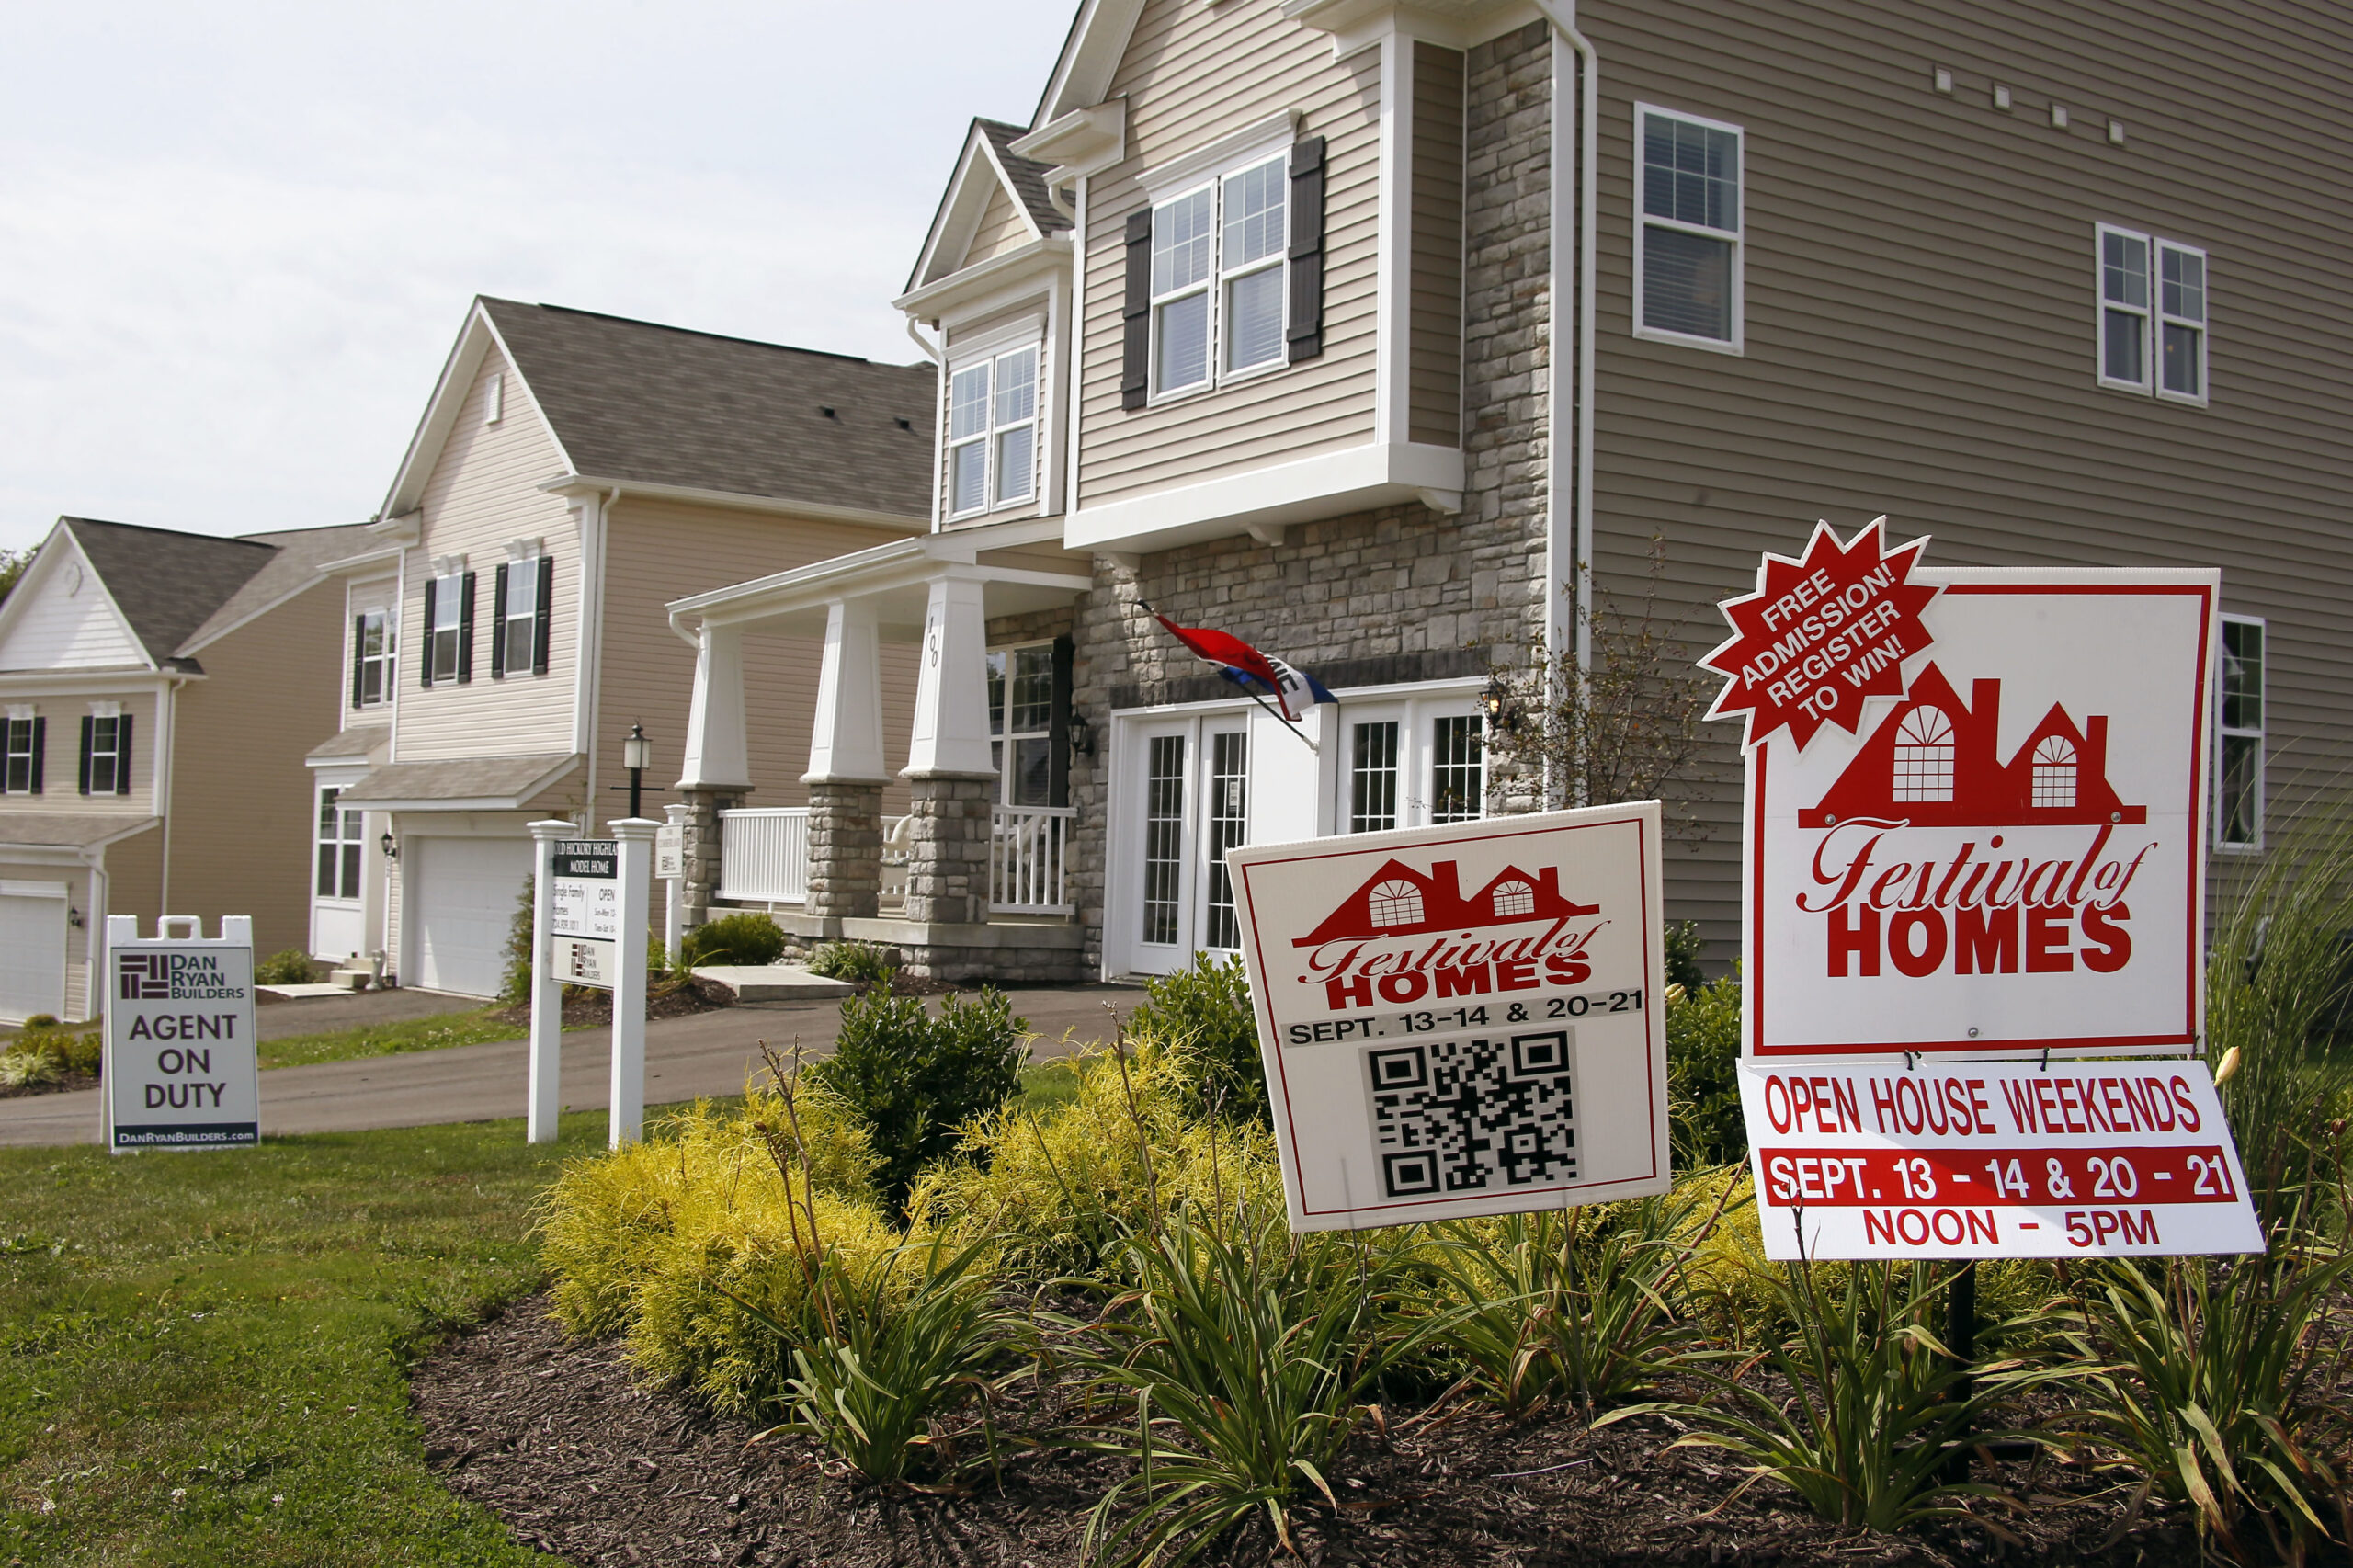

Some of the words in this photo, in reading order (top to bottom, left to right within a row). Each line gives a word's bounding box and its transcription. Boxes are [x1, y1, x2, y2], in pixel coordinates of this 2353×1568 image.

[1761, 567, 1836, 632] FREE
[929, 616, 938, 667] 100
[1741, 562, 1897, 691] ADMISSION!
[1766, 599, 1902, 708] REGISTER
[1797, 686, 1838, 721] TO
[1841, 633, 1906, 688] WIN!
[566, 842, 592, 855] HICKORY
[570, 860, 590, 873] MODEL
[591, 860, 608, 873] HOME
[1795, 816, 2114, 913] Festival
[2094, 841, 2158, 910] of
[599, 888, 615, 901] OPEN
[583, 944, 594, 956] DAN
[1297, 916, 1571, 984] Festival
[1551, 919, 1612, 958] of
[1827, 900, 2132, 978] HOMES
[170, 954, 216, 971] DAN
[170, 971, 224, 987] RYAN
[583, 956, 596, 969] RYAN
[583, 968, 601, 980] BUILDERS
[1325, 950, 1592, 1010] HOMES
[171, 987, 244, 999] BUILDERS
[129, 1014, 237, 1040] AGENT
[1289, 1017, 1385, 1045] SEPT.
[1399, 1006, 1490, 1034] 13-14
[1506, 1003, 1529, 1023] &
[1546, 989, 1643, 1019] 20-21
[158, 1048, 210, 1074] ON
[145, 1083, 226, 1108] DUTY
[1764, 1074, 1862, 1134] OPEN
[1870, 1076, 1997, 1136] HOUSE
[1999, 1074, 2201, 1134] WEEKENDS
[1770, 1156, 1881, 1199] SEPT.
[1893, 1157, 1938, 1199] 13
[1985, 1158, 2029, 1199] 14
[2046, 1157, 2075, 1199] &
[2086, 1155, 2138, 1198] 20
[2187, 1154, 2232, 1195] 21
[1862, 1209, 2000, 1246] NOON
[2065, 1209, 2161, 1248] 5PM
